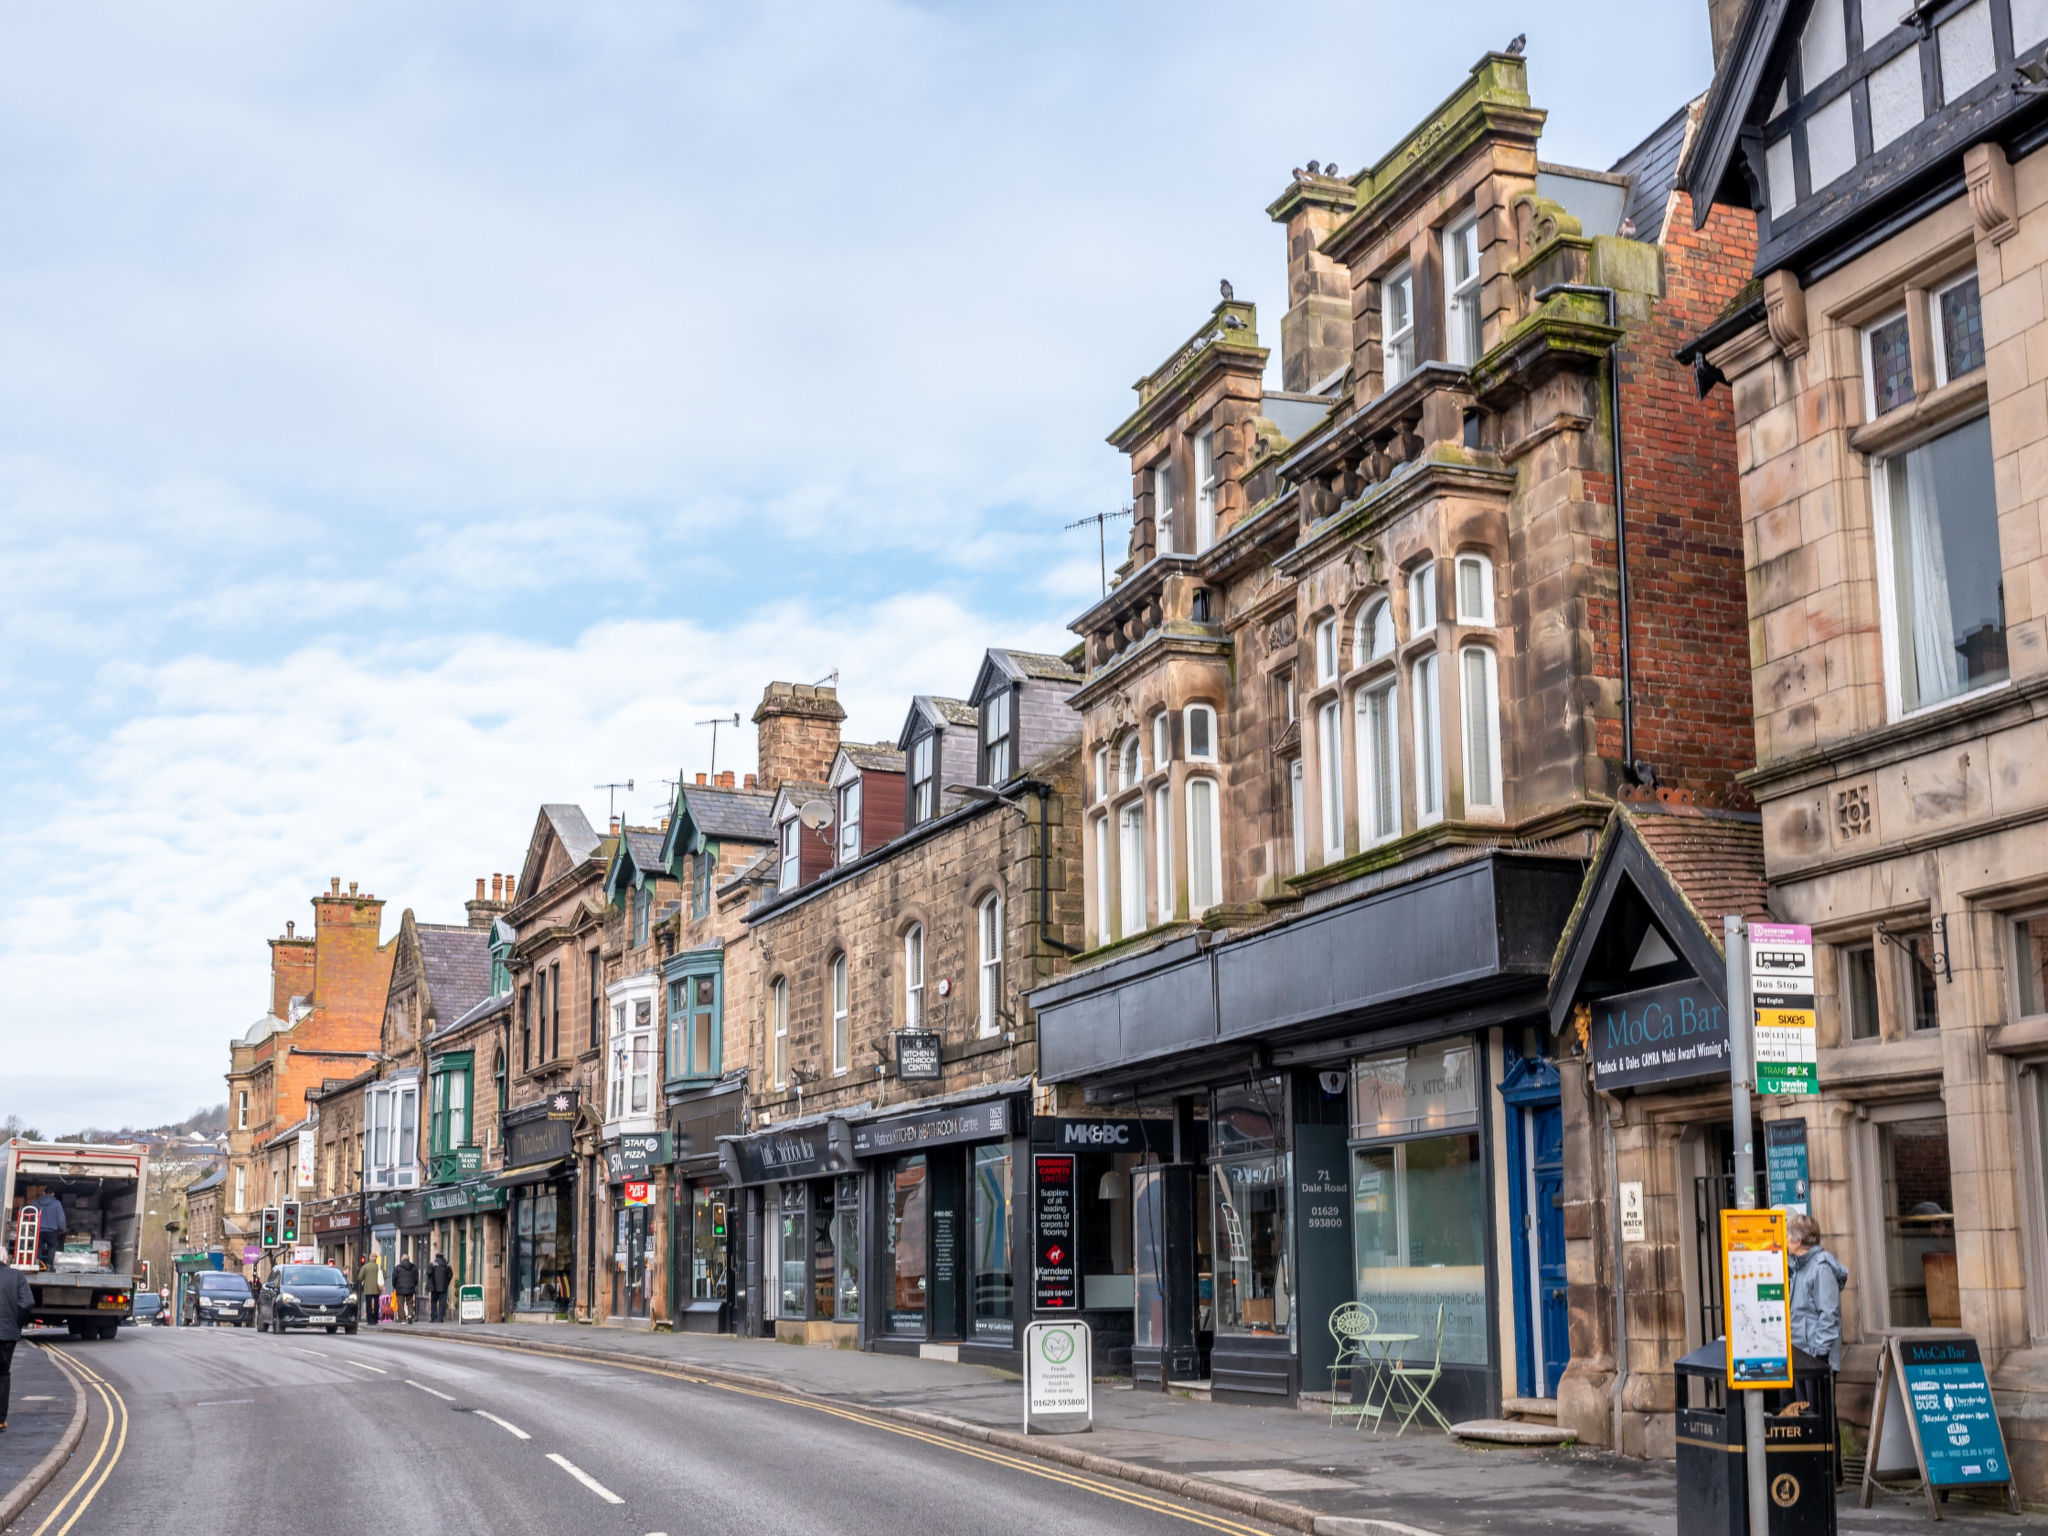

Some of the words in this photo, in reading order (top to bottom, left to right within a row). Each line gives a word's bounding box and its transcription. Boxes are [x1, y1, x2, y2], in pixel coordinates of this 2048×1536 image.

[1756, 980, 1773, 988] Bus
[1777, 981, 1798, 990] Stop
[1607, 1003, 1675, 1050] MoCa
[1679, 997, 1721, 1035] Bar
[1778, 1014, 1805, 1025] sixes
[904, 1050, 929, 1058] KITCHEN
[1758, 1049, 1770, 1057] 140
[902, 1057, 937, 1065] BATHROOM
[1597, 1059, 1617, 1075] Matlock
[1626, 1056, 1640, 1069] Dales
[1642, 1051, 1660, 1067] CAMRA
[1662, 1048, 1676, 1064] Multi
[1678, 1045, 1696, 1061] Award
[1697, 1041, 1722, 1059] Winning
[1423, 1075, 1462, 1095] KITCHEN
[959, 1116, 978, 1133] Centre
[1065, 1123, 1129, 1145] MK&BC
[624, 1139, 645, 1148] STAR
[624, 1151, 646, 1159] PIZZA
[611, 1152, 624, 1173] STA
[1318, 1170, 1330, 1181] 71
[629, 1184, 645, 1192] JUST
[1302, 1184, 1321, 1192] Dale
[1325, 1184, 1347, 1192] Road
[632, 1190, 645, 1198] EAT
[1041, 1189, 1069, 1199] Suppliers
[430, 1194, 447, 1210] SCARGILL
[1043, 1205, 1066, 1213] leading
[1312, 1207, 1339, 1216] 01629
[1041, 1221, 1063, 1229] carpets
[1309, 1219, 1342, 1227] 593800
[1043, 1229, 1067, 1237] flooring
[1039, 1267, 1072, 1275] Karndean
[1913, 1345, 1946, 1360] MoCa
[1947, 1346, 1966, 1359] Bar
[1943, 1382, 1958, 1390] blue
[1959, 1382, 1984, 1392] monkey
[1058, 1398, 1085, 1406] 593800
[1915, 1401, 1940, 1410] DUCK
[1690, 1422, 1713, 1436] LITTER
[1764, 1426, 1801, 1438] LITTER
